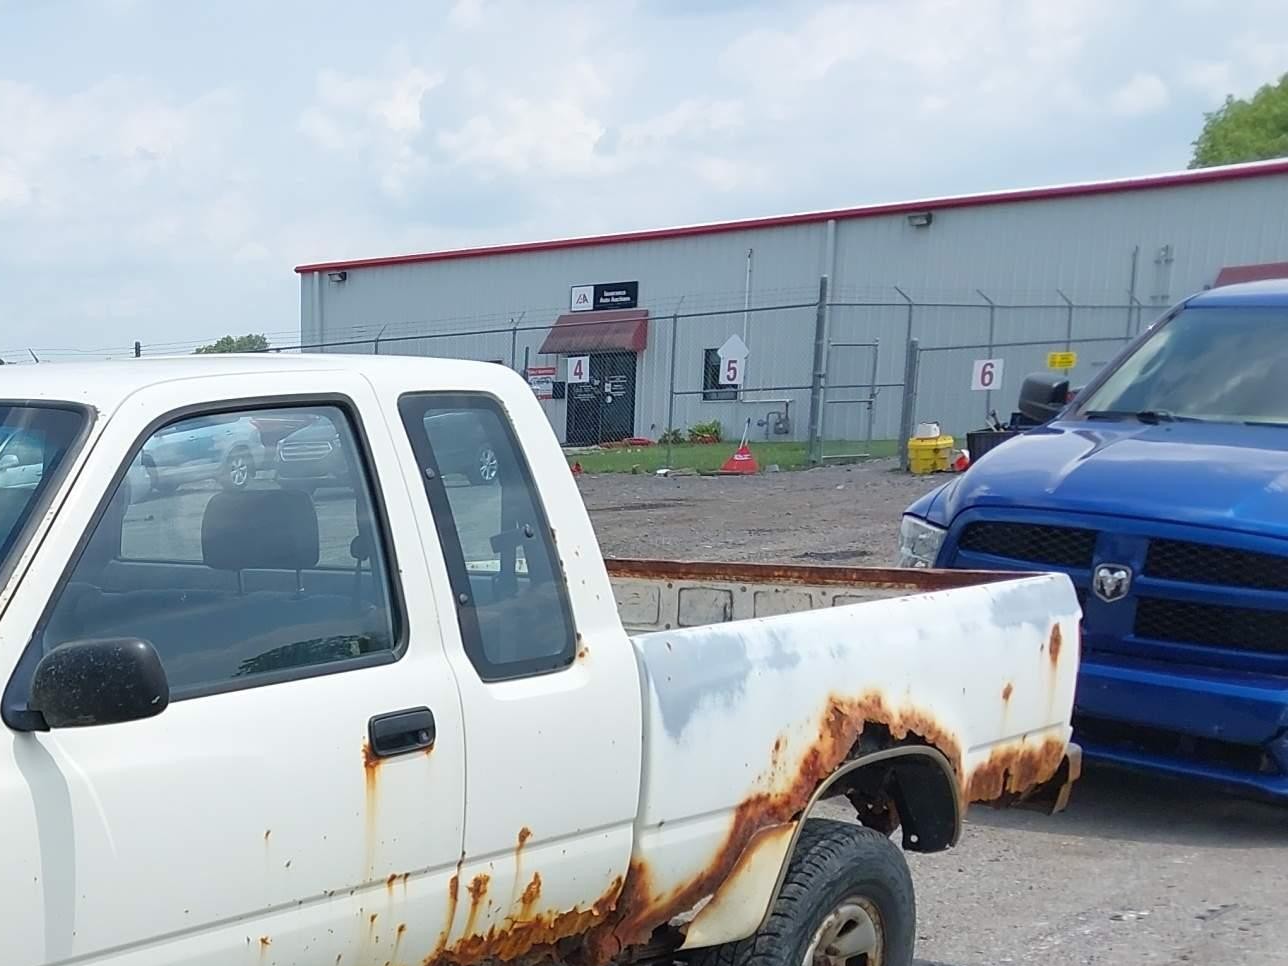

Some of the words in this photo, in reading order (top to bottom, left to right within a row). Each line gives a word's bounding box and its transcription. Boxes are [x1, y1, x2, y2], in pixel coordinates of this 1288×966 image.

[573, 359, 583, 380] 4
[726, 359, 738, 381] 5
[980, 362, 995, 387] 6
